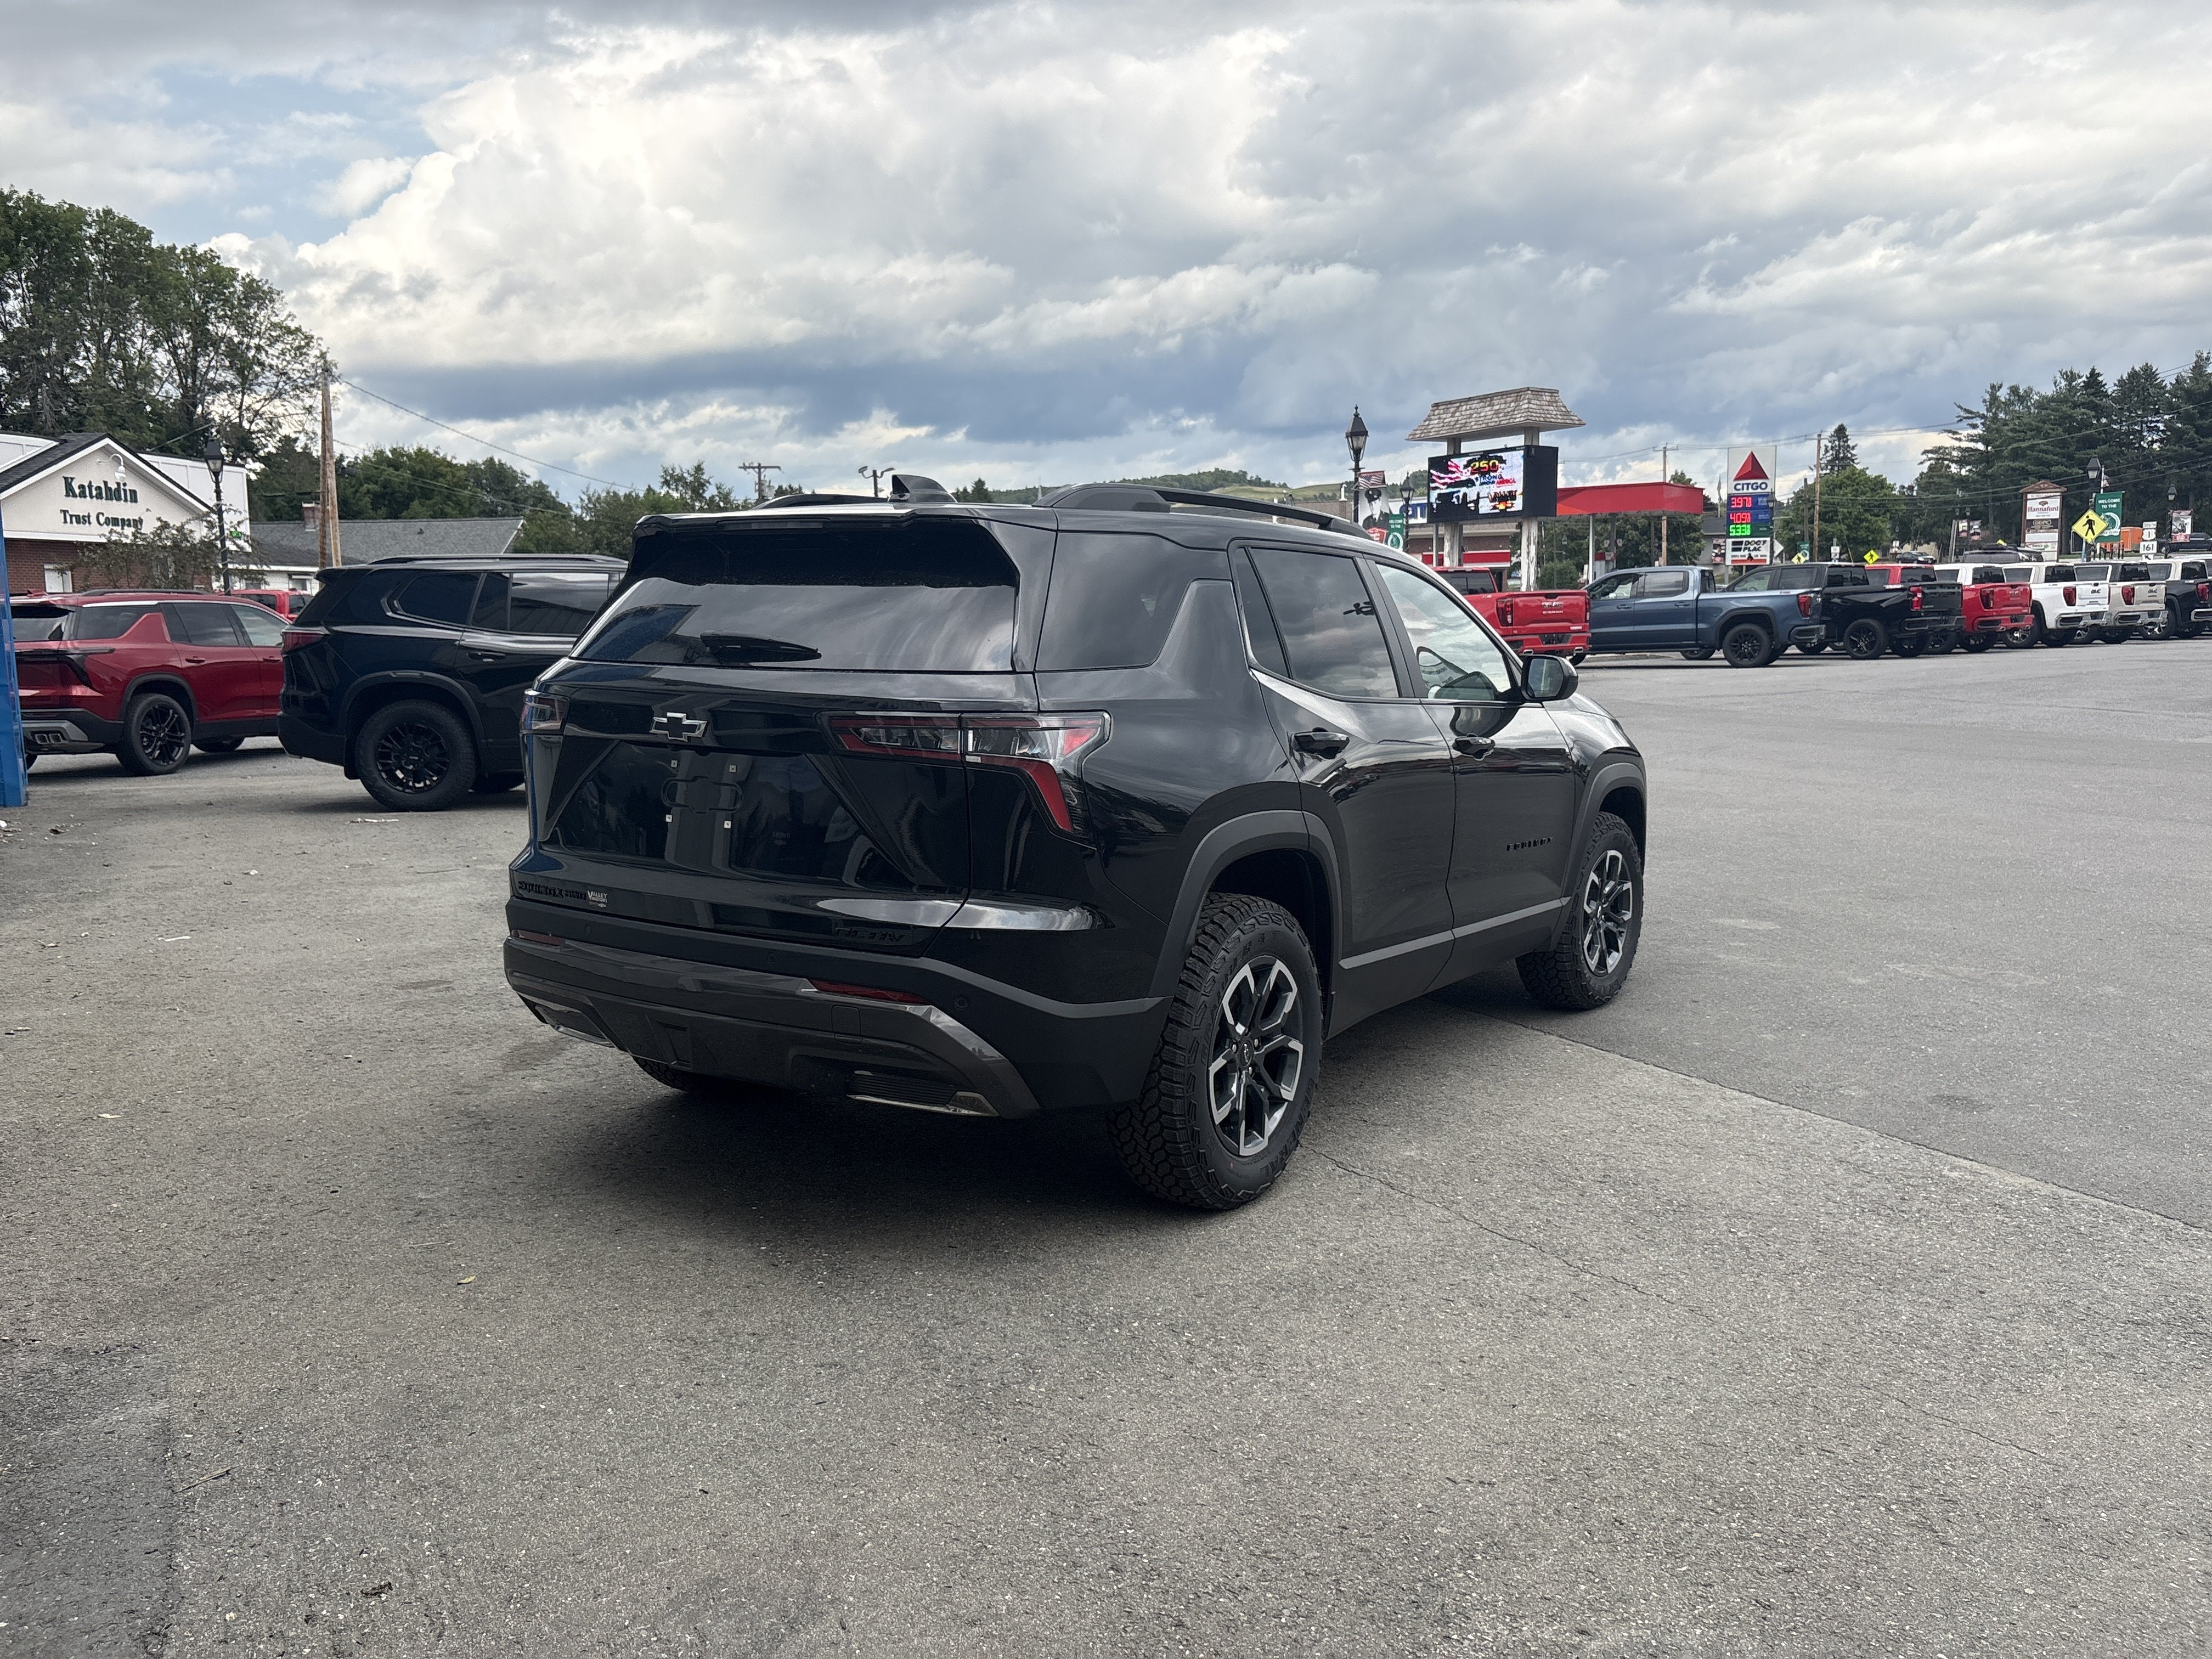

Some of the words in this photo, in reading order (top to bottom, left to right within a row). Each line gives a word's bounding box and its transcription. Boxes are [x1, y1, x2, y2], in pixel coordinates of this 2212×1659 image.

[1470, 459, 1499, 474] 250
[63, 476, 138, 503] Katahdin
[1734, 482, 1768, 491] CITGO
[60, 509, 92, 526] Trust
[95, 511, 144, 531] Company
[2148, 531, 2151, 539] 1
[587, 890, 607, 900] VALLEY
